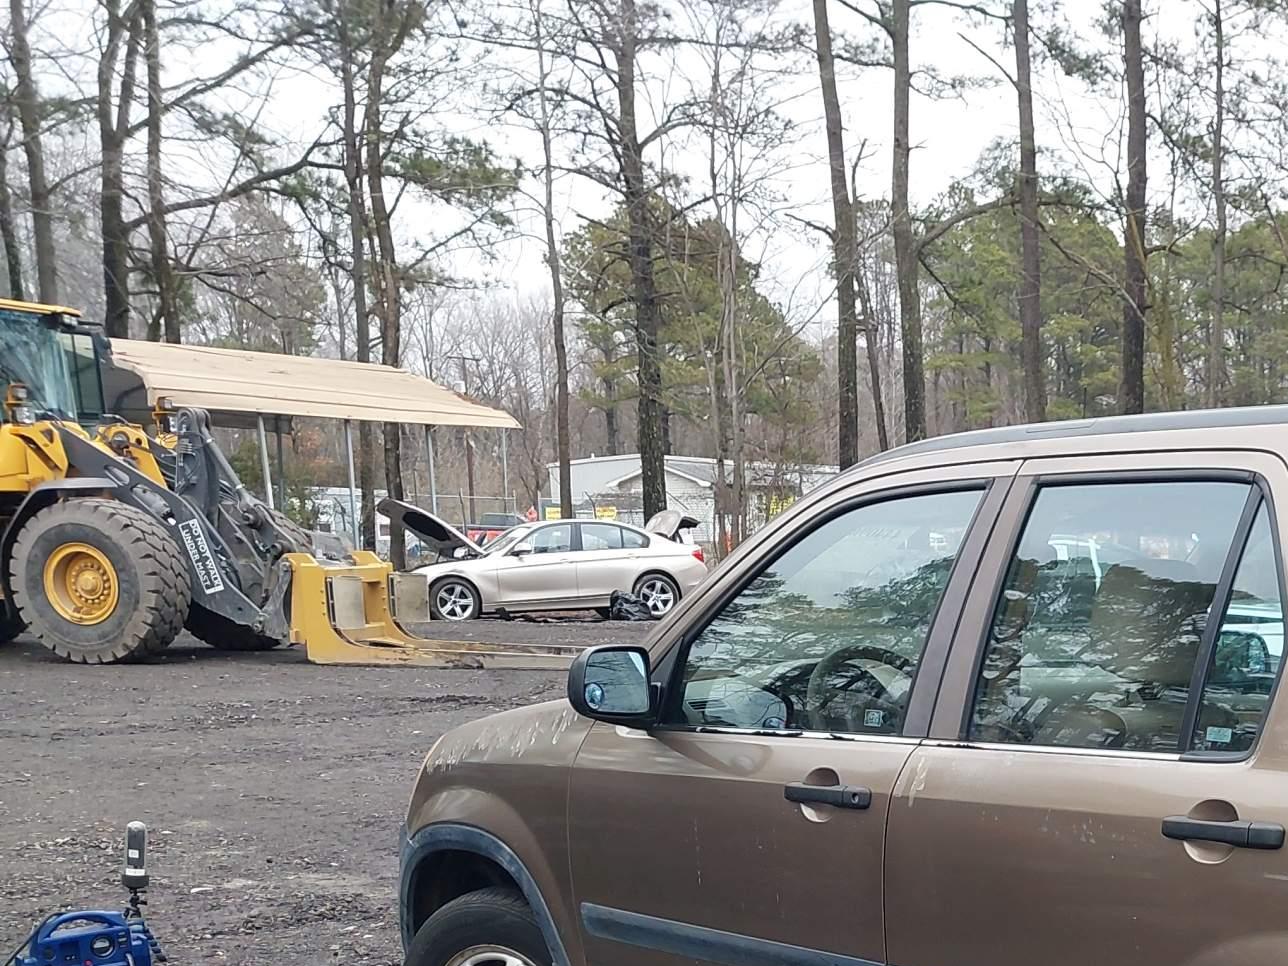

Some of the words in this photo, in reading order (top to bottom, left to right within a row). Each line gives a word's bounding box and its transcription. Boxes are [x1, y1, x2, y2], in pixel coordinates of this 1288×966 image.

[183, 529, 200, 560] UNDER
[196, 562, 211, 586] MAST
[189, 520, 201, 536] DO
[196, 537, 209, 557] NOT
[205, 557, 222, 587] WALK
